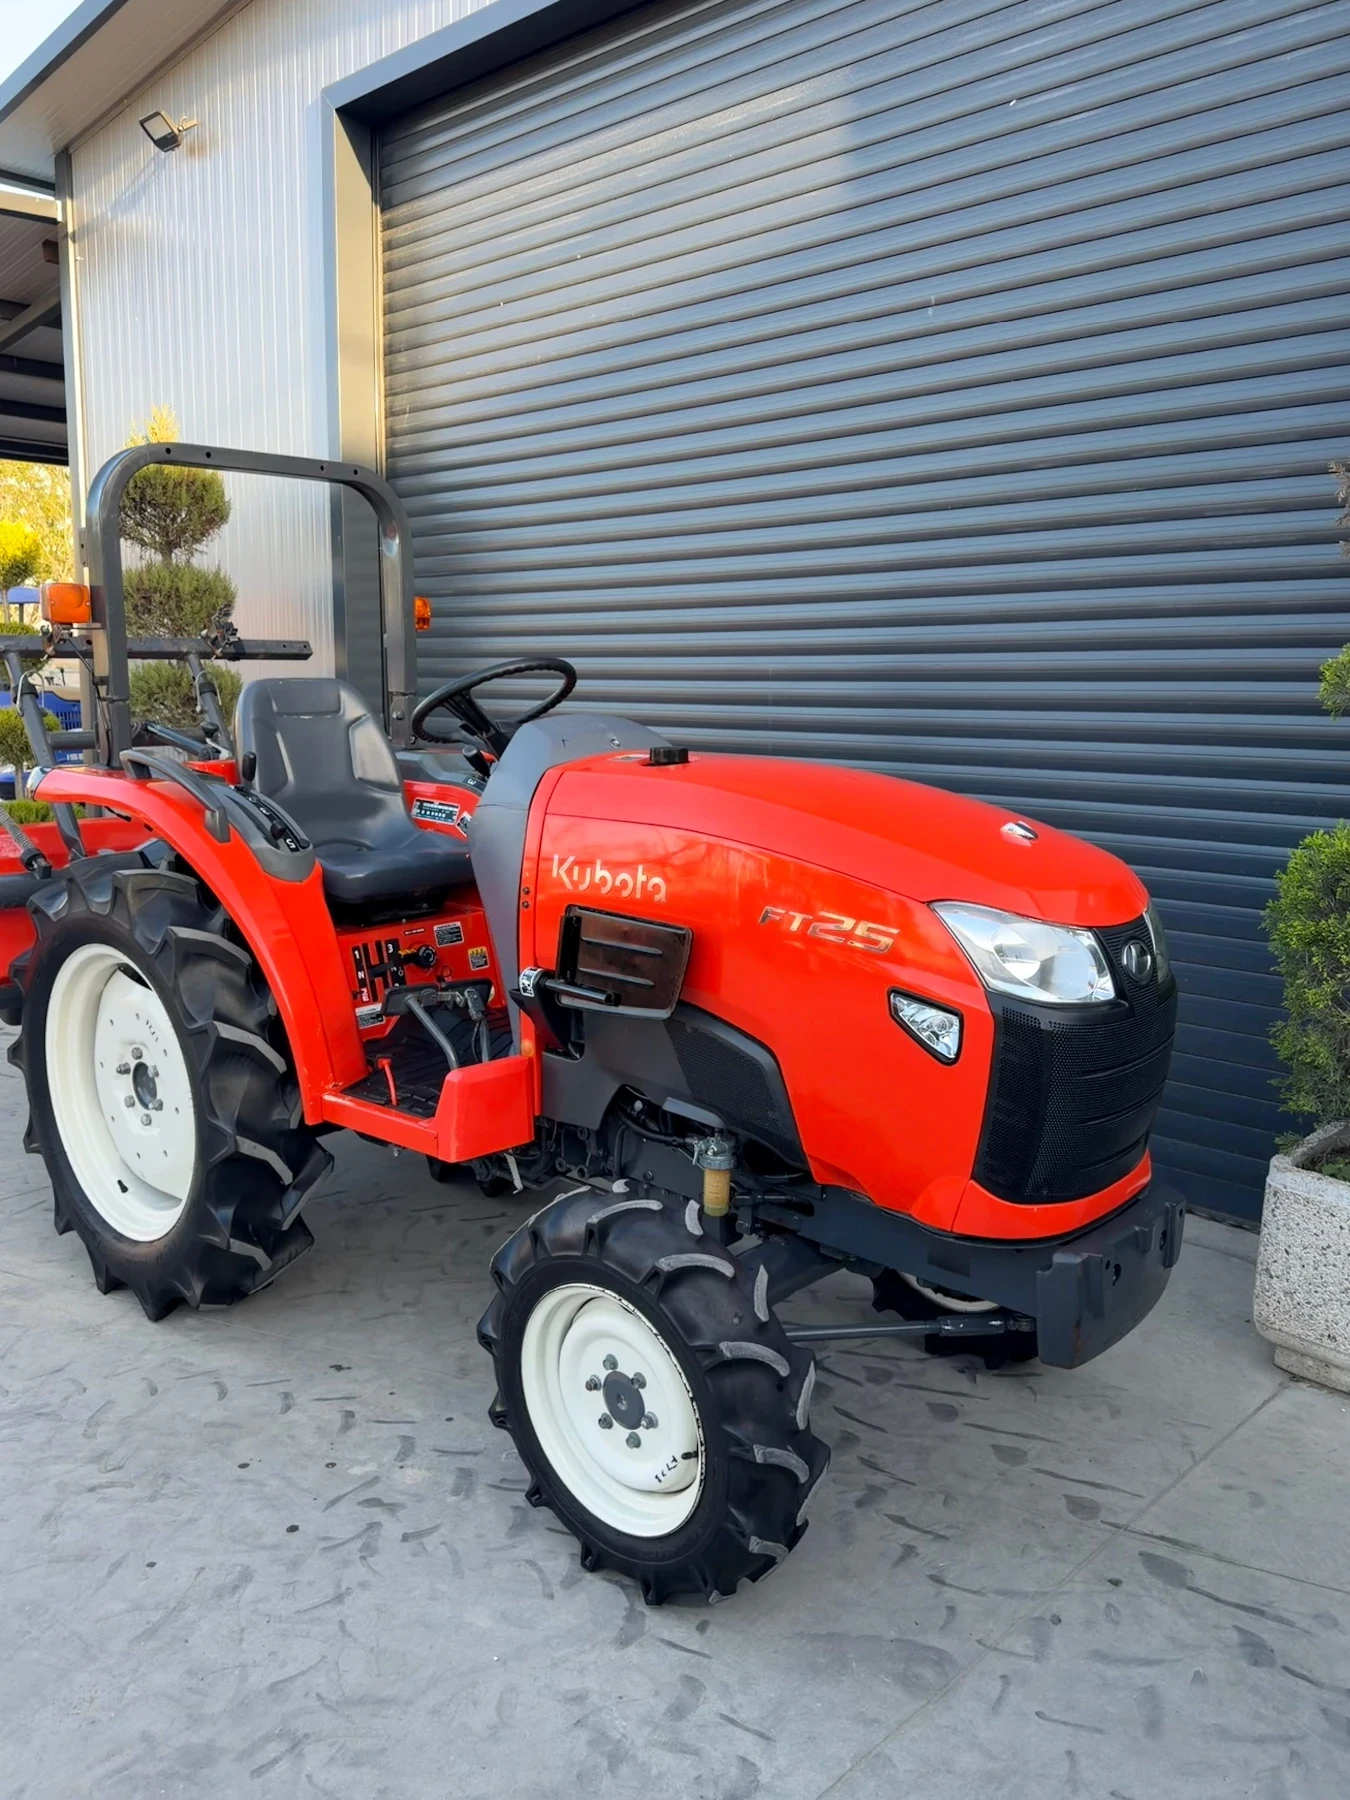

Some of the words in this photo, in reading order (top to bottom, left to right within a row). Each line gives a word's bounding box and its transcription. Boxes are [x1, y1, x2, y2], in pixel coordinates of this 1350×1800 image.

[552, 854, 667, 903] Kubota
[758, 905, 900, 954] FT25
[354, 950, 360, 960] 1
[387, 943, 394, 954] 3
